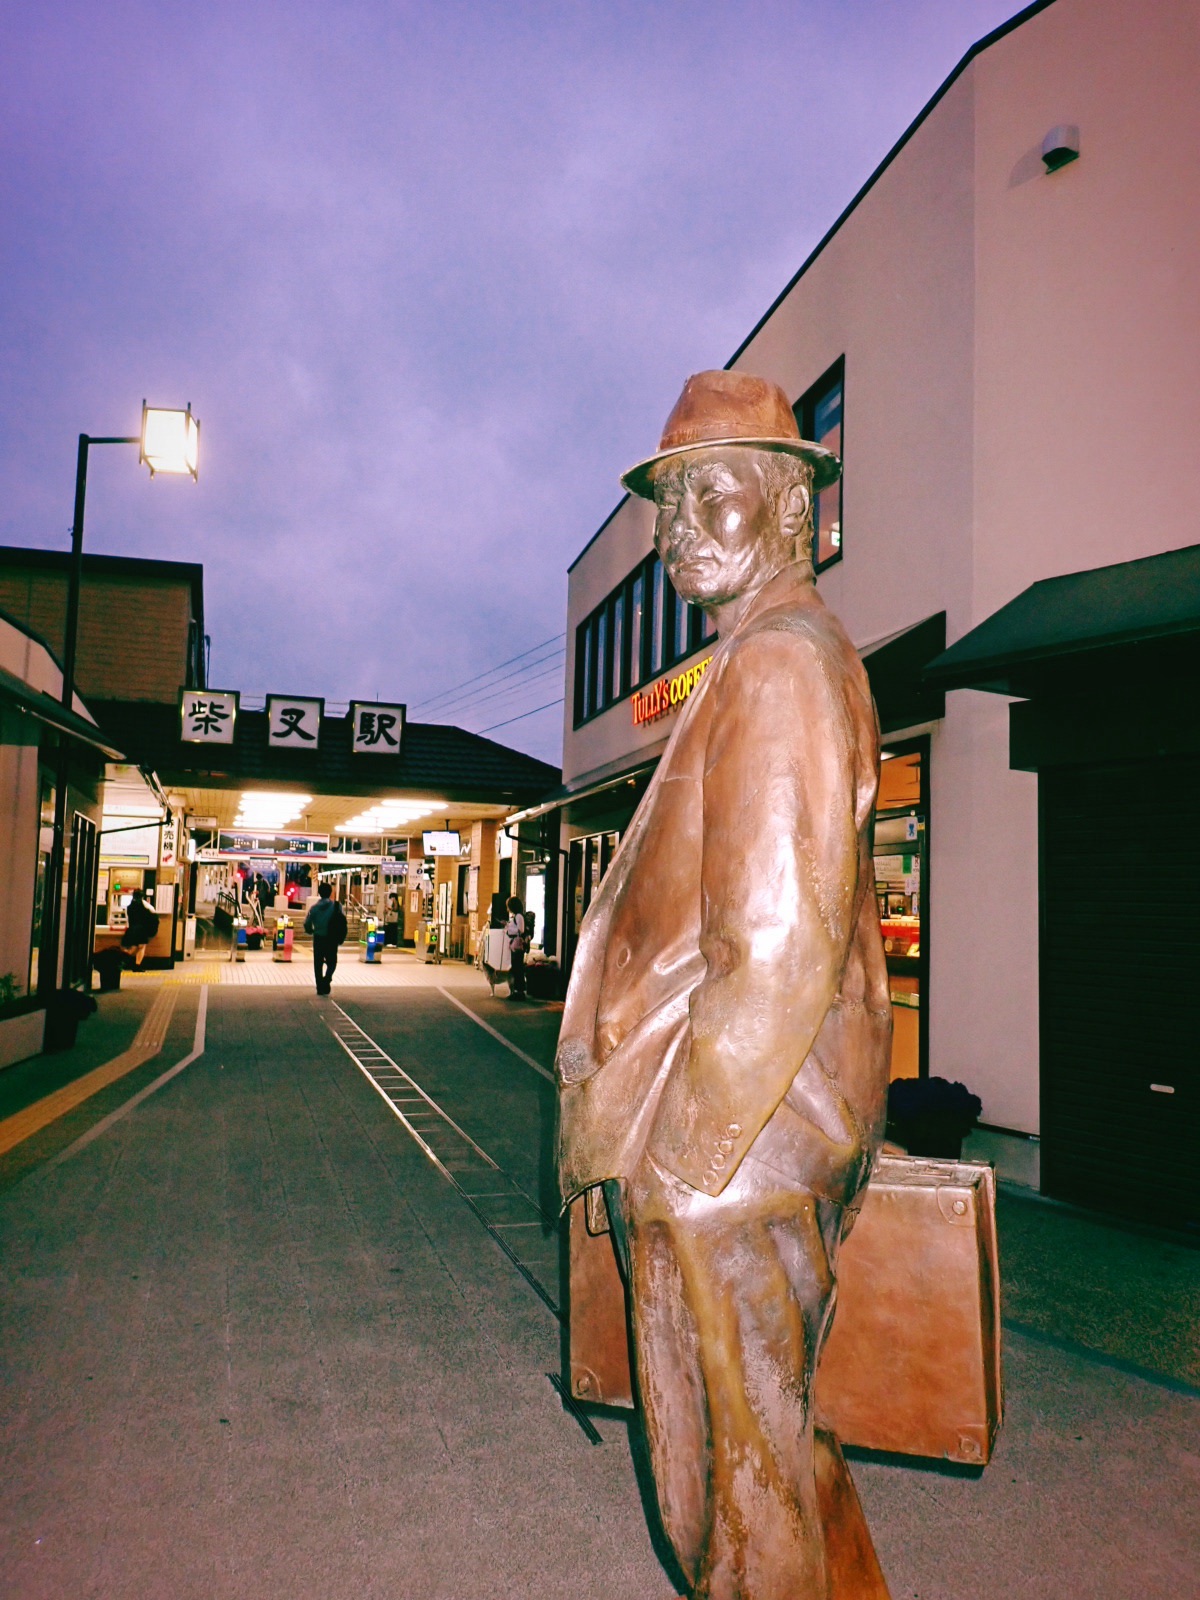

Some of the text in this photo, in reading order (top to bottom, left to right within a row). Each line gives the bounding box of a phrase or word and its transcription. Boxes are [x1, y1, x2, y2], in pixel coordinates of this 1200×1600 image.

[670, 656, 713, 705] COFF
[188, 700, 398, 746] 柴又駅
